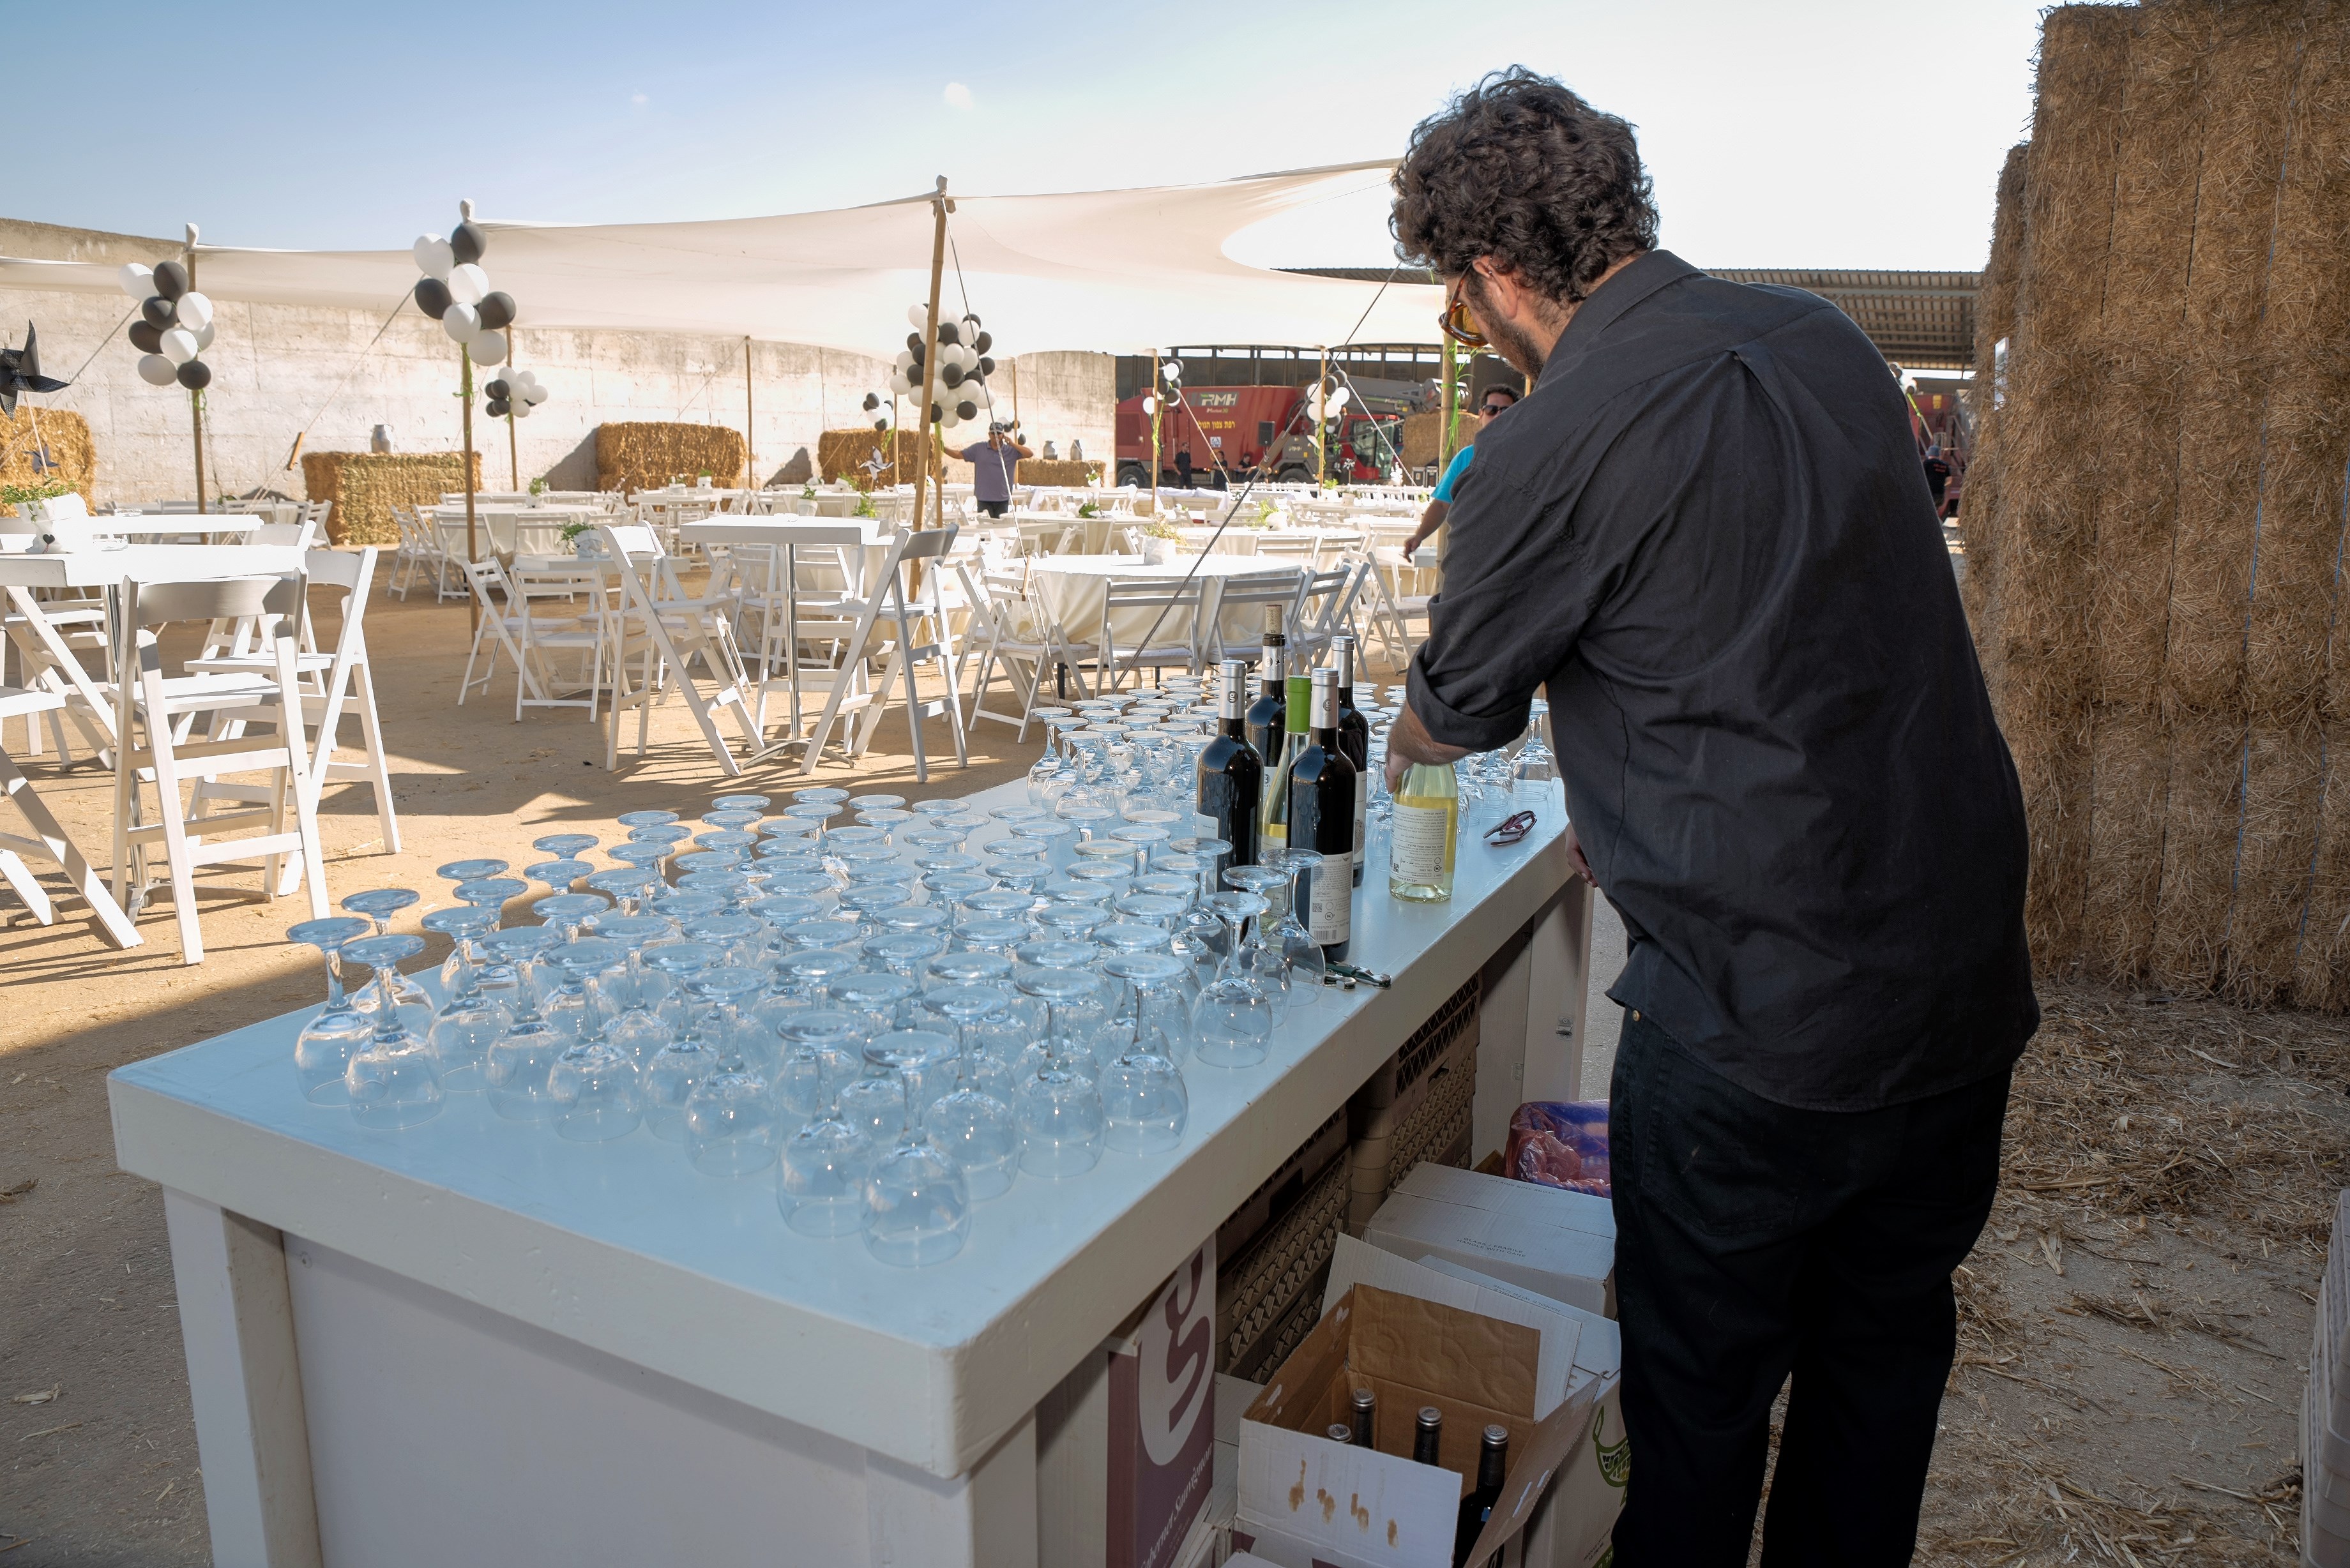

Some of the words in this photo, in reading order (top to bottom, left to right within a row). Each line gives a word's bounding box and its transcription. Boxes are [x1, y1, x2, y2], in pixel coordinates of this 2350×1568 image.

[1201, 394, 1237, 406] RMH
[1212, 421, 1223, 430] צפון
[1224, 421, 1235, 429] רפת
[1457, 1239, 1484, 1249] HANDLE
[1464, 1237, 1487, 1246] GLASS
[1494, 1245, 1524, 1253] FRAGILE
[1492, 1285, 1512, 1293] CARE
[1513, 1292, 1530, 1301] WITH
[1533, 1300, 1561, 1313] HANDLE
[1174, 1442, 1213, 1522] Sauvignon
